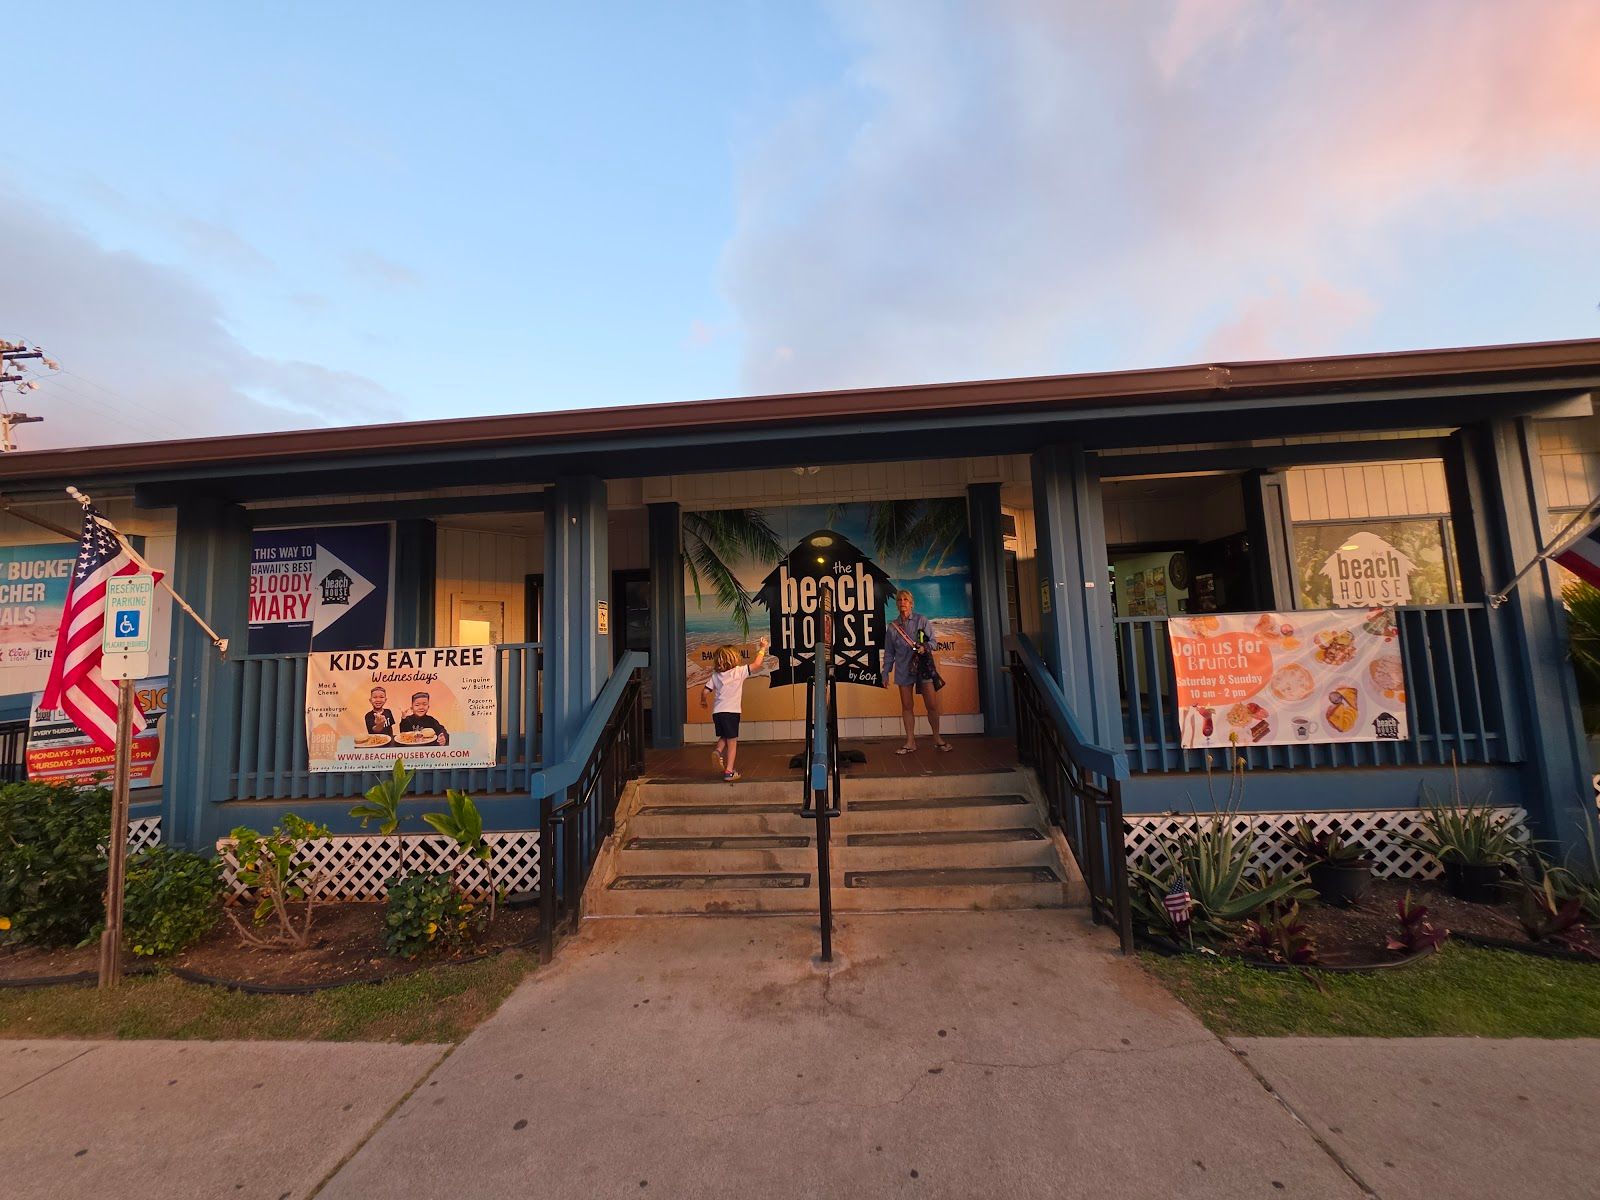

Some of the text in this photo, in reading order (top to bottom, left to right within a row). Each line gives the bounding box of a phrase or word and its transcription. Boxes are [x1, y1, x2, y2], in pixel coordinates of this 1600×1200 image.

[254, 545, 313, 560] THIS WAY TO
[7, 558, 77, 580] BUCKET
[251, 561, 313, 575] HAWAII'S BEST
[833, 561, 852, 574] the
[1336, 550, 1401, 580] beach
[110, 583, 150, 594] RESERVED
[250, 572, 313, 594] BLOODY
[325, 576, 349, 589] beach
[1340, 579, 1403, 600] HOUSE
[324, 587, 348, 597] HOUSE
[111, 596, 147, 607] PARKING
[248, 593, 312, 622] MARY
[0, 605, 36, 626] ALS
[35, 647, 53, 660] Lite
[1174, 638, 1263, 657] Join us for
[330, 648, 483, 671] KIDS EAT FREE
[1188, 654, 1249, 671] Brunch
[371, 670, 438, 684] Wednesdays
[848, 669, 877, 684] by 604
[1177, 673, 1263, 687] Saturday & Sunday
[137, 687, 168, 712] SIC
[1190, 689, 1200, 699] 10
[1202, 690, 1216, 699] am
[1224, 687, 1231, 698] 2
[1232, 689, 1248, 699] pm
[308, 706, 348, 714] Cheeseburger
[52, 727, 78, 735] THURSDAY
[30, 751, 70, 760] MONDAYS:
[77, 755, 115, 765] SATURDAYS
[337, 750, 470, 761] WWW.BEACHHOUSEBY604.COM
